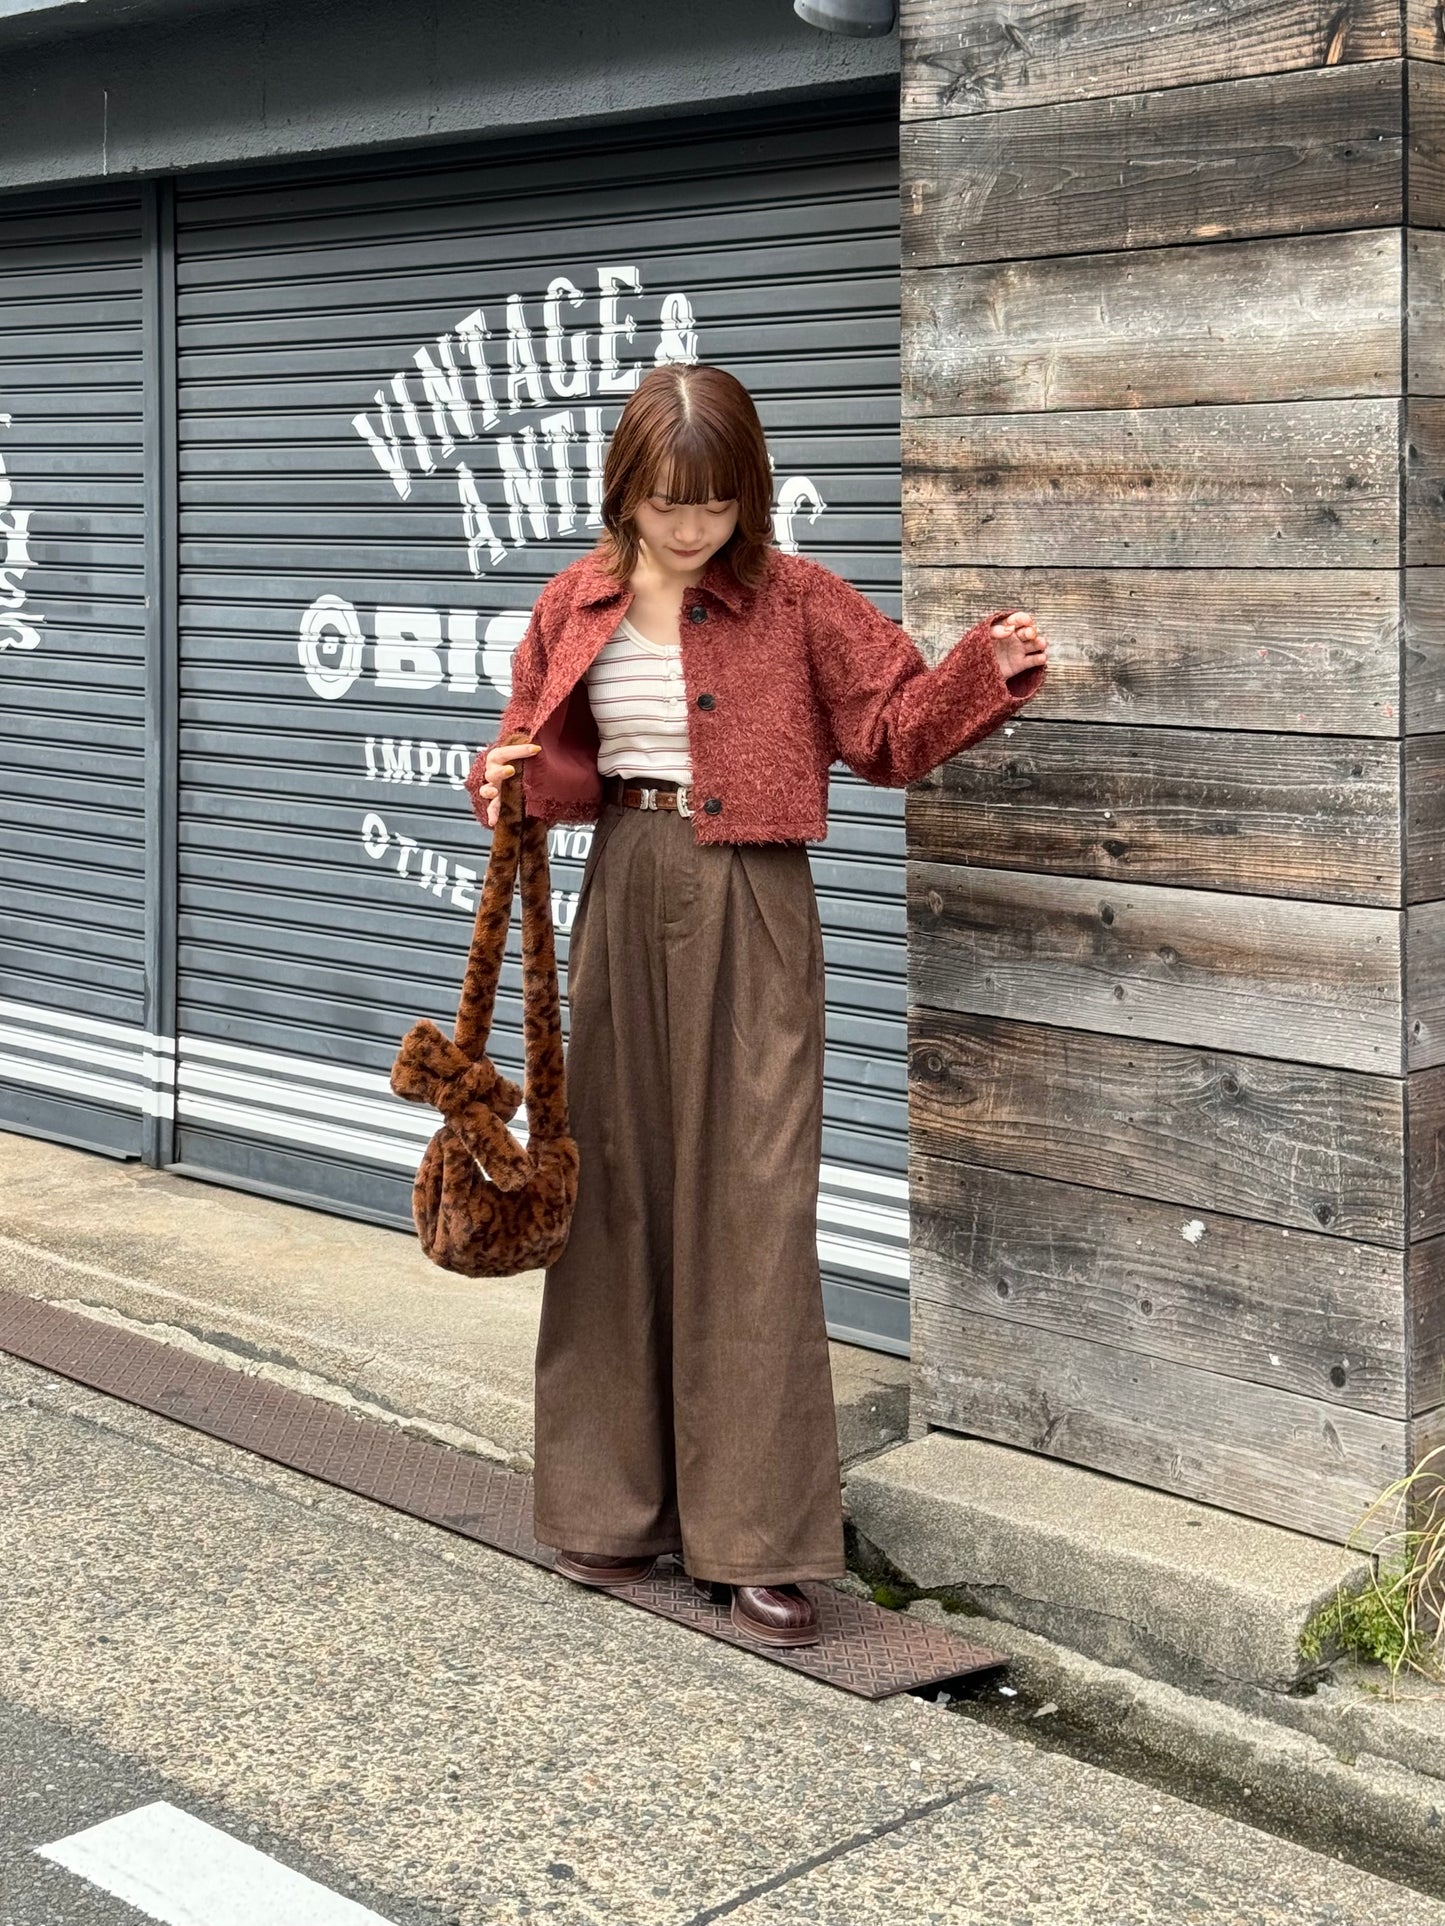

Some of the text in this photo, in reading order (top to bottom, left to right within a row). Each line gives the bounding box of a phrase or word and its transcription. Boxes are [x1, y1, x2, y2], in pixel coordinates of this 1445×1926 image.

[351, 266, 643, 501] VINTAGE
[365, 737, 489, 791] IMPO
[362, 813, 477, 913] OTHE
